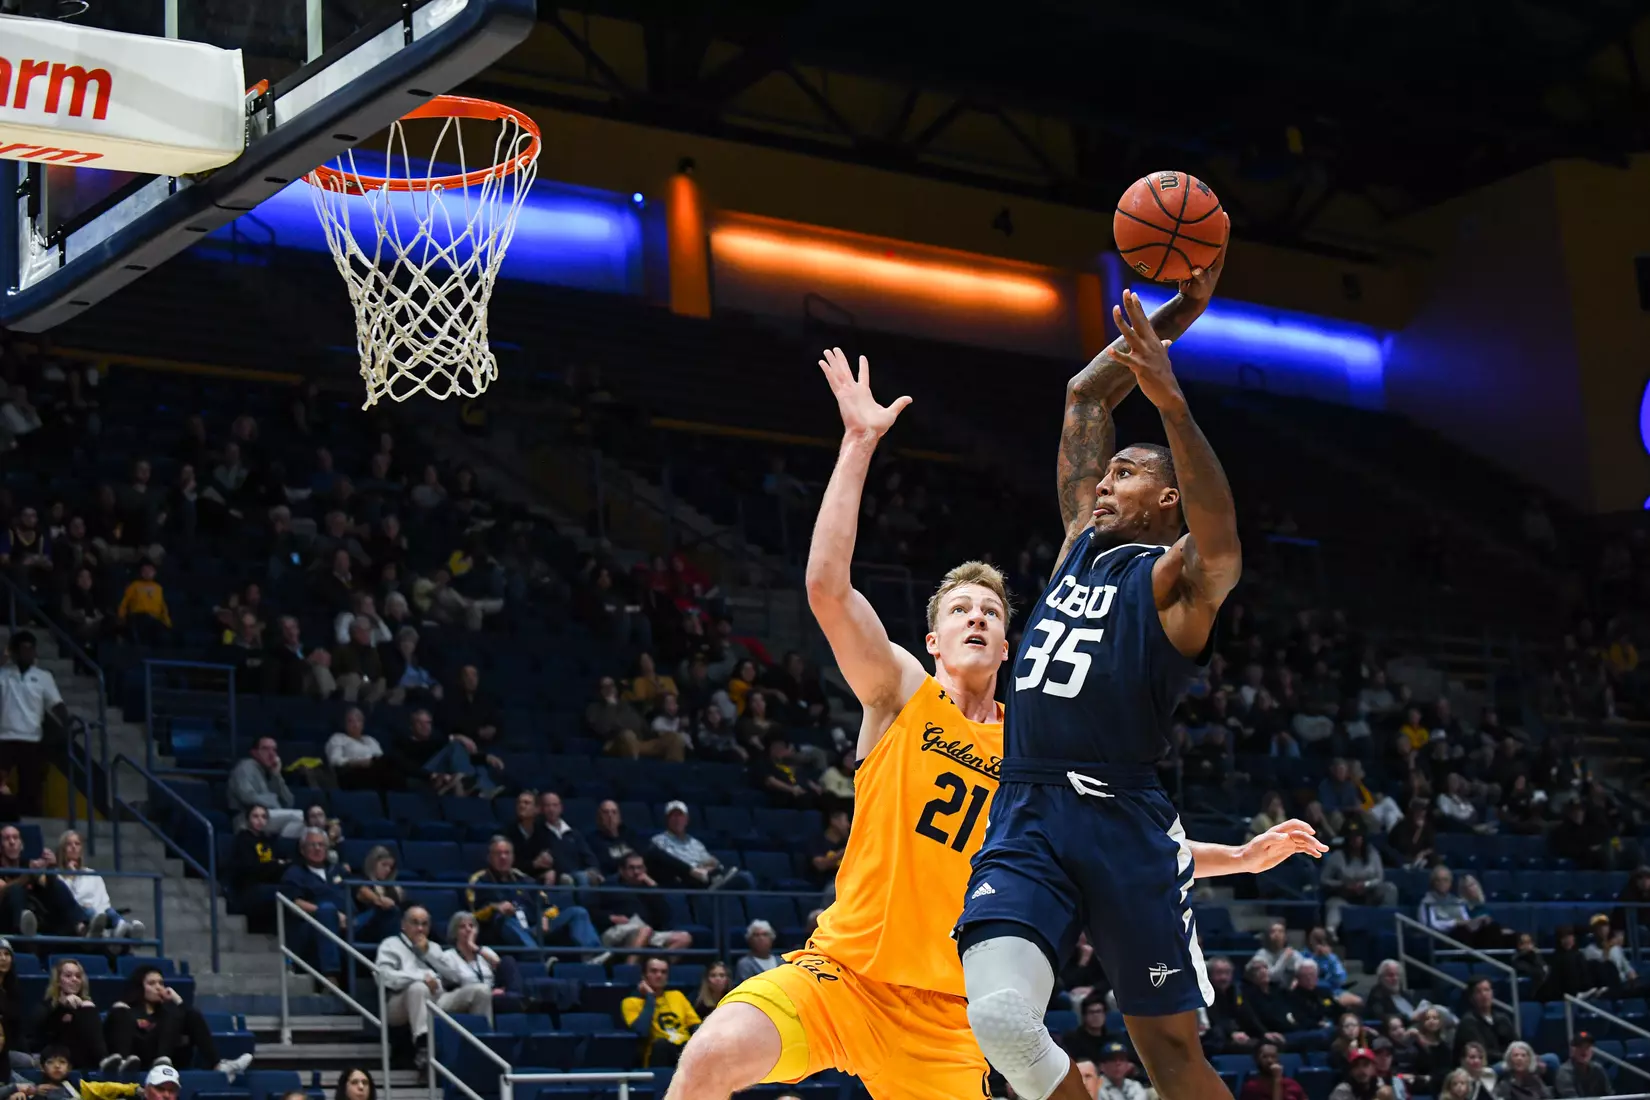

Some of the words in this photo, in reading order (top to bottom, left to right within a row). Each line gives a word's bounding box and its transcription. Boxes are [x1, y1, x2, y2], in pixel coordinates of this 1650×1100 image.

[1046, 575, 1117, 618] CBU
[1015, 618, 1104, 698] 35
[921, 722, 982, 768] Golden
[915, 772, 989, 853] 21
